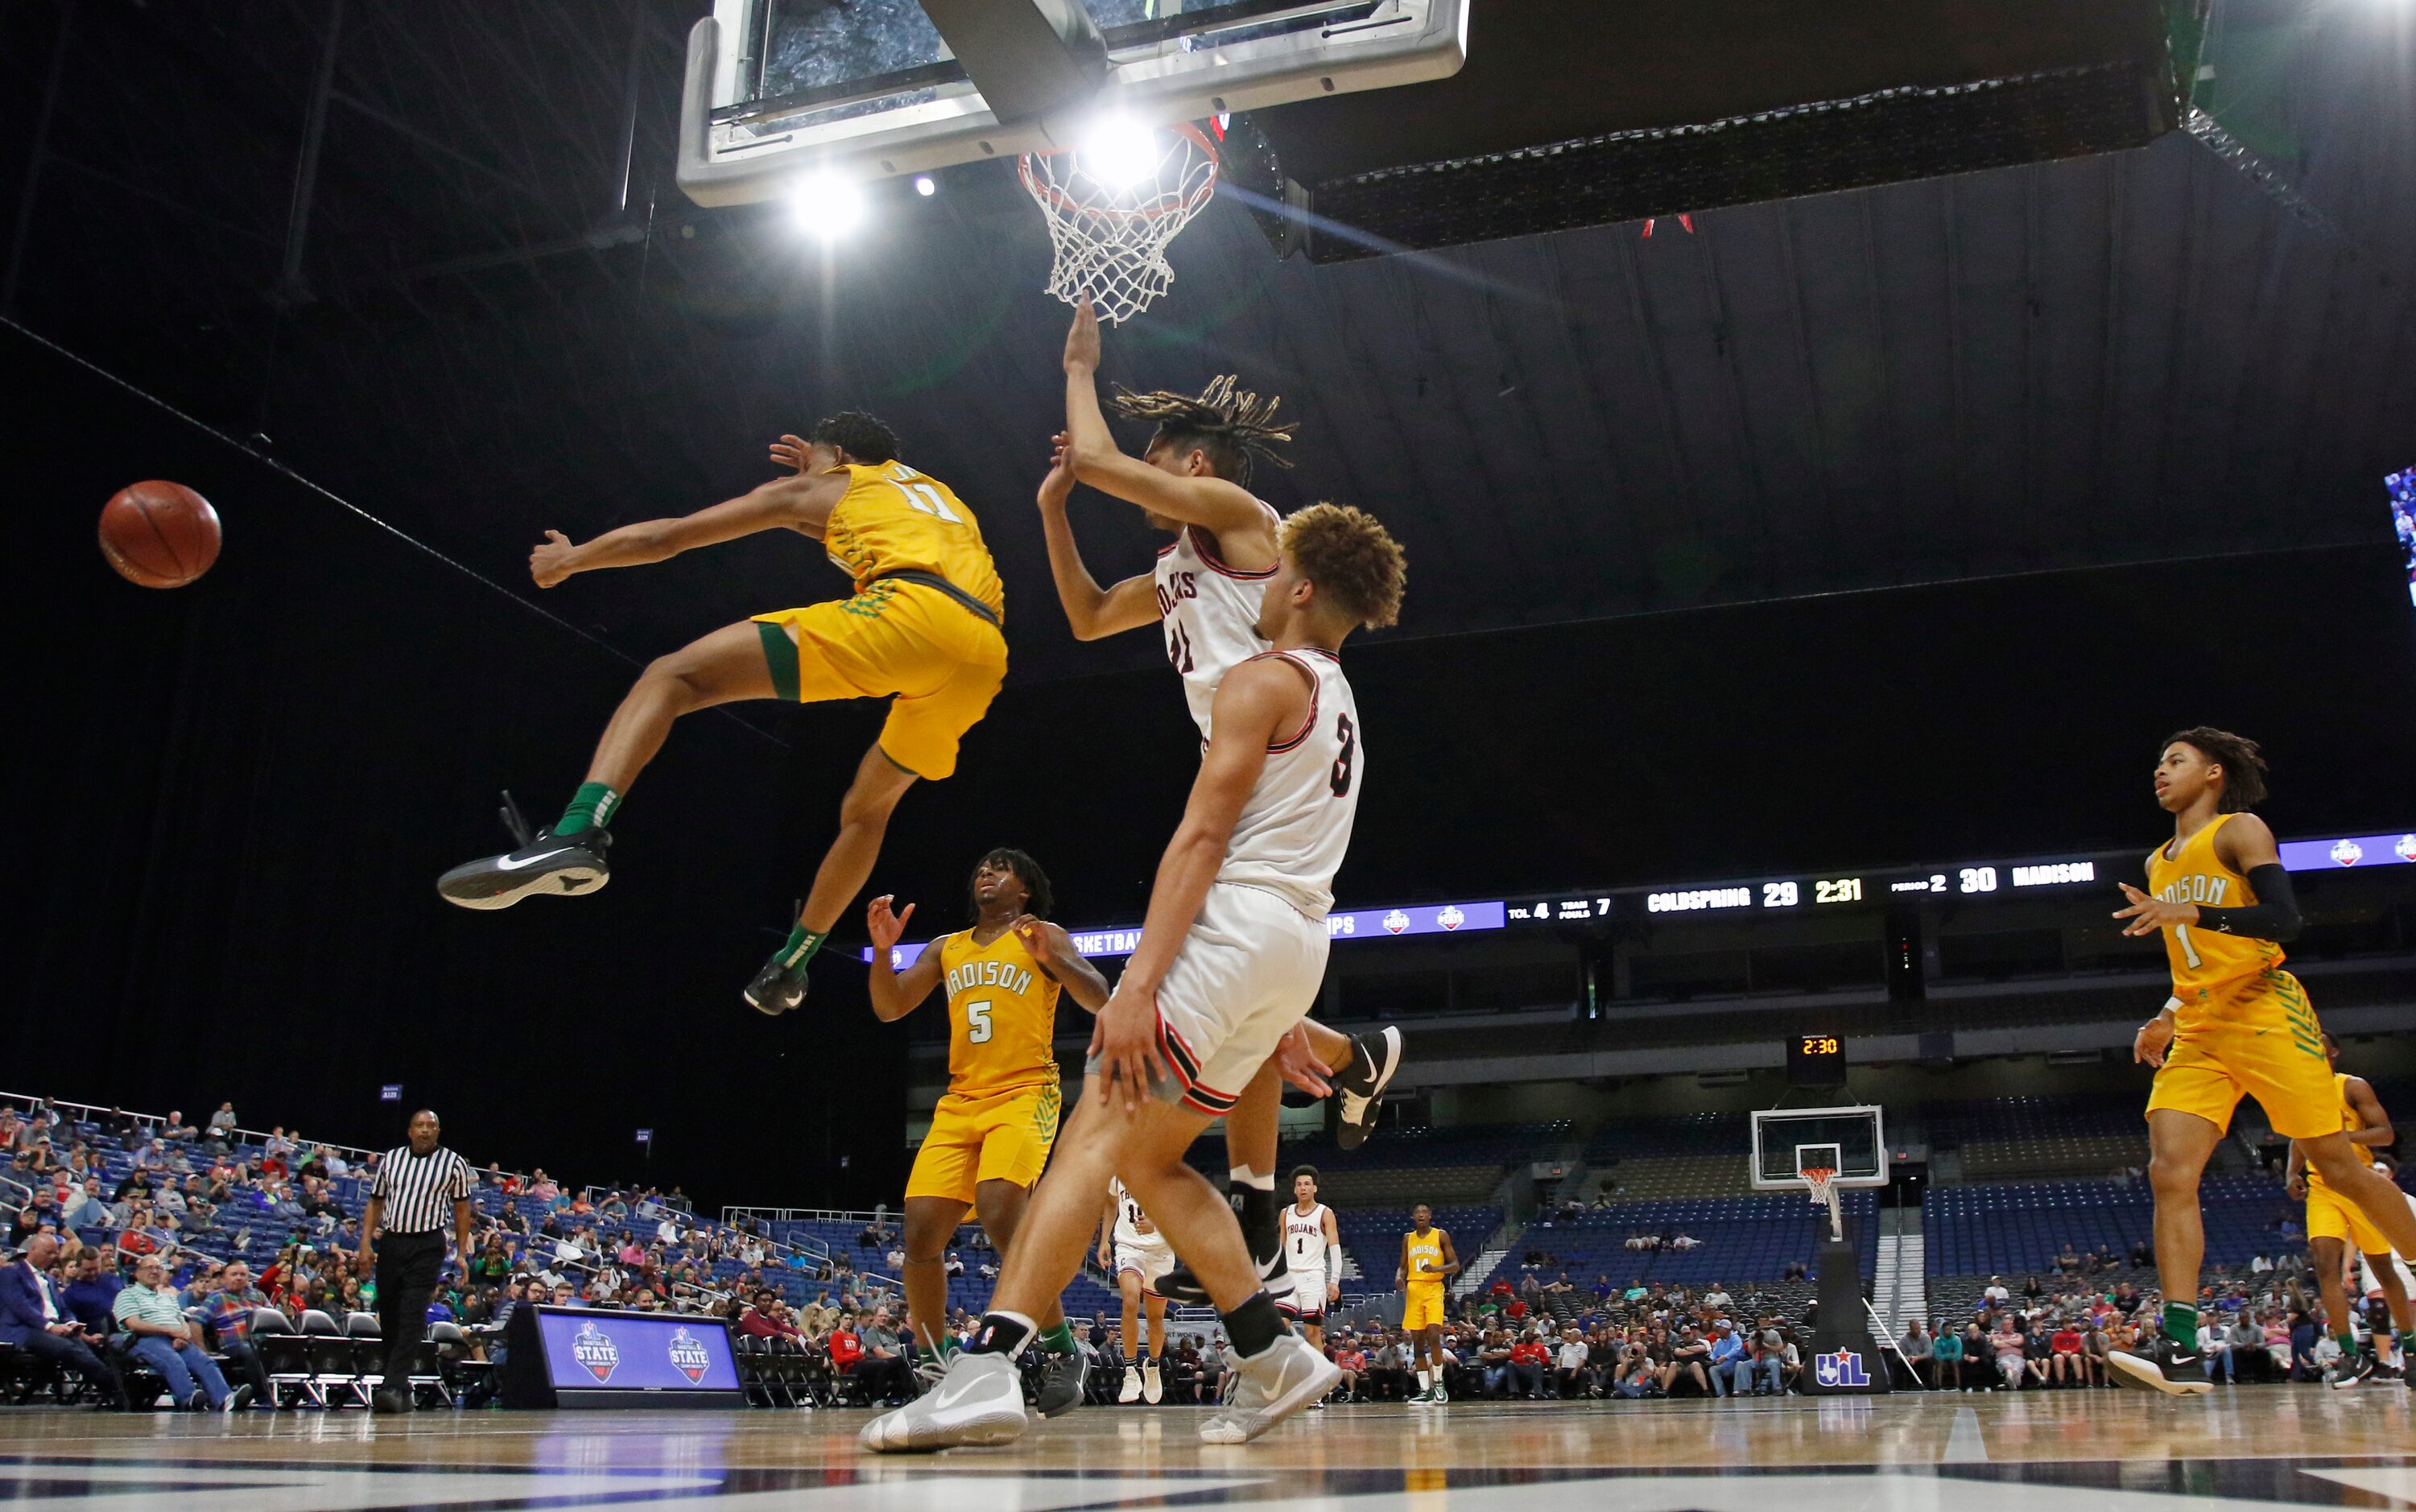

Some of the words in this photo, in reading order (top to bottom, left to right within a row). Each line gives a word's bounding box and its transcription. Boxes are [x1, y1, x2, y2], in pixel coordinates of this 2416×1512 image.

[886, 478, 964, 525] 11
[1330, 713, 1355, 798] 3
[1891, 882, 1928, 891] PERIOD
[1930, 874, 1947, 892] 2
[1960, 867, 1997, 893] 30
[2012, 862, 2094, 886] MADISON
[1647, 887, 1751, 912] COLDSPRING
[1763, 882, 1798, 907] 29
[1815, 878, 1862, 903] 2:31
[1508, 909, 1530, 919] TOL
[1534, 903, 1550, 919] 4
[1560, 901, 1588, 910] TEAM
[1596, 899, 1610, 915] 7
[1559, 911, 1590, 919] FOULS
[2176, 923, 2203, 969] 1
[967, 1000, 993, 1044] 5
[1803, 1039, 1837, 1055] 2:30
[1288, 1223, 1317, 1237] TROJANS
[1297, 1237, 1303, 1254] 1
[576, 1345, 617, 1361] STATE
[671, 1349, 708, 1363] STATE
[1815, 1347, 1871, 1386] UIL
